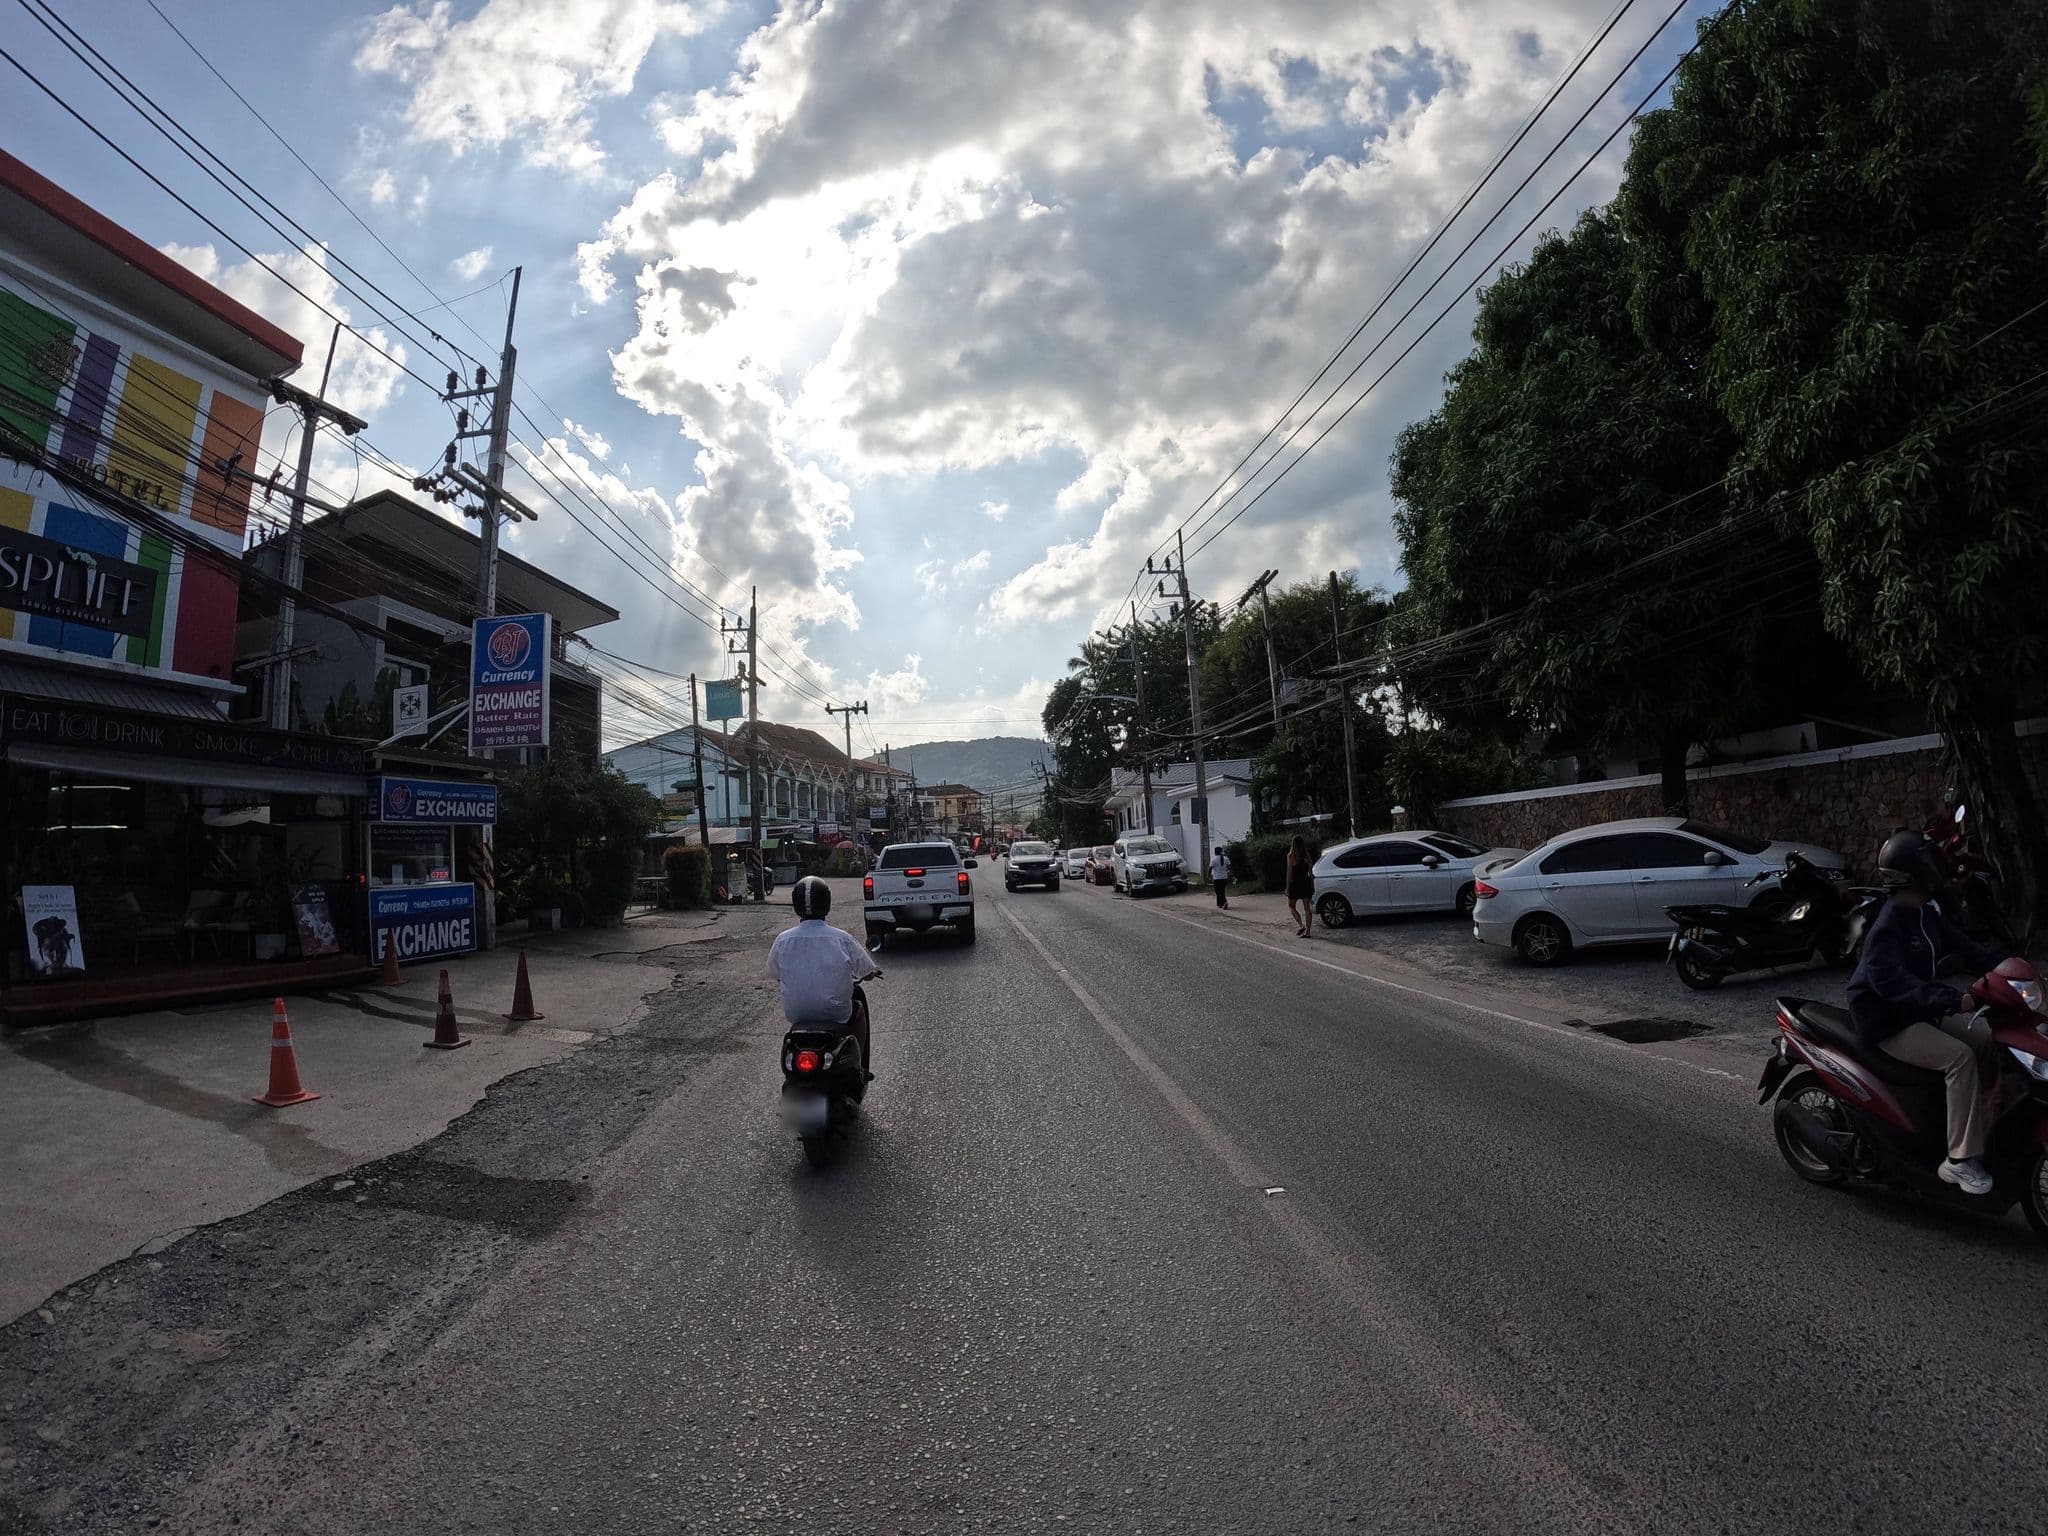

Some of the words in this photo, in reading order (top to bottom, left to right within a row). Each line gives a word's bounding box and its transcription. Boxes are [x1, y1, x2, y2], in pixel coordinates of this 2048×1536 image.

[71, 453, 168, 508] HOTEL
[0, 545, 149, 616] SPLIFF
[481, 669, 536, 683] Currency
[475, 689, 541, 712] EXCHANGE
[476, 713, 510, 723] Better
[513, 711, 540, 720] Rate
[12, 708, 50, 733] EAT
[104, 718, 167, 746] DRINK
[416, 788, 442, 798] Currency
[415, 799, 495, 818] EXCHANGE
[378, 900, 409, 913] Currency
[881, 893, 952, 903] RANGER
[377, 918, 471, 960] EXCHANGE
